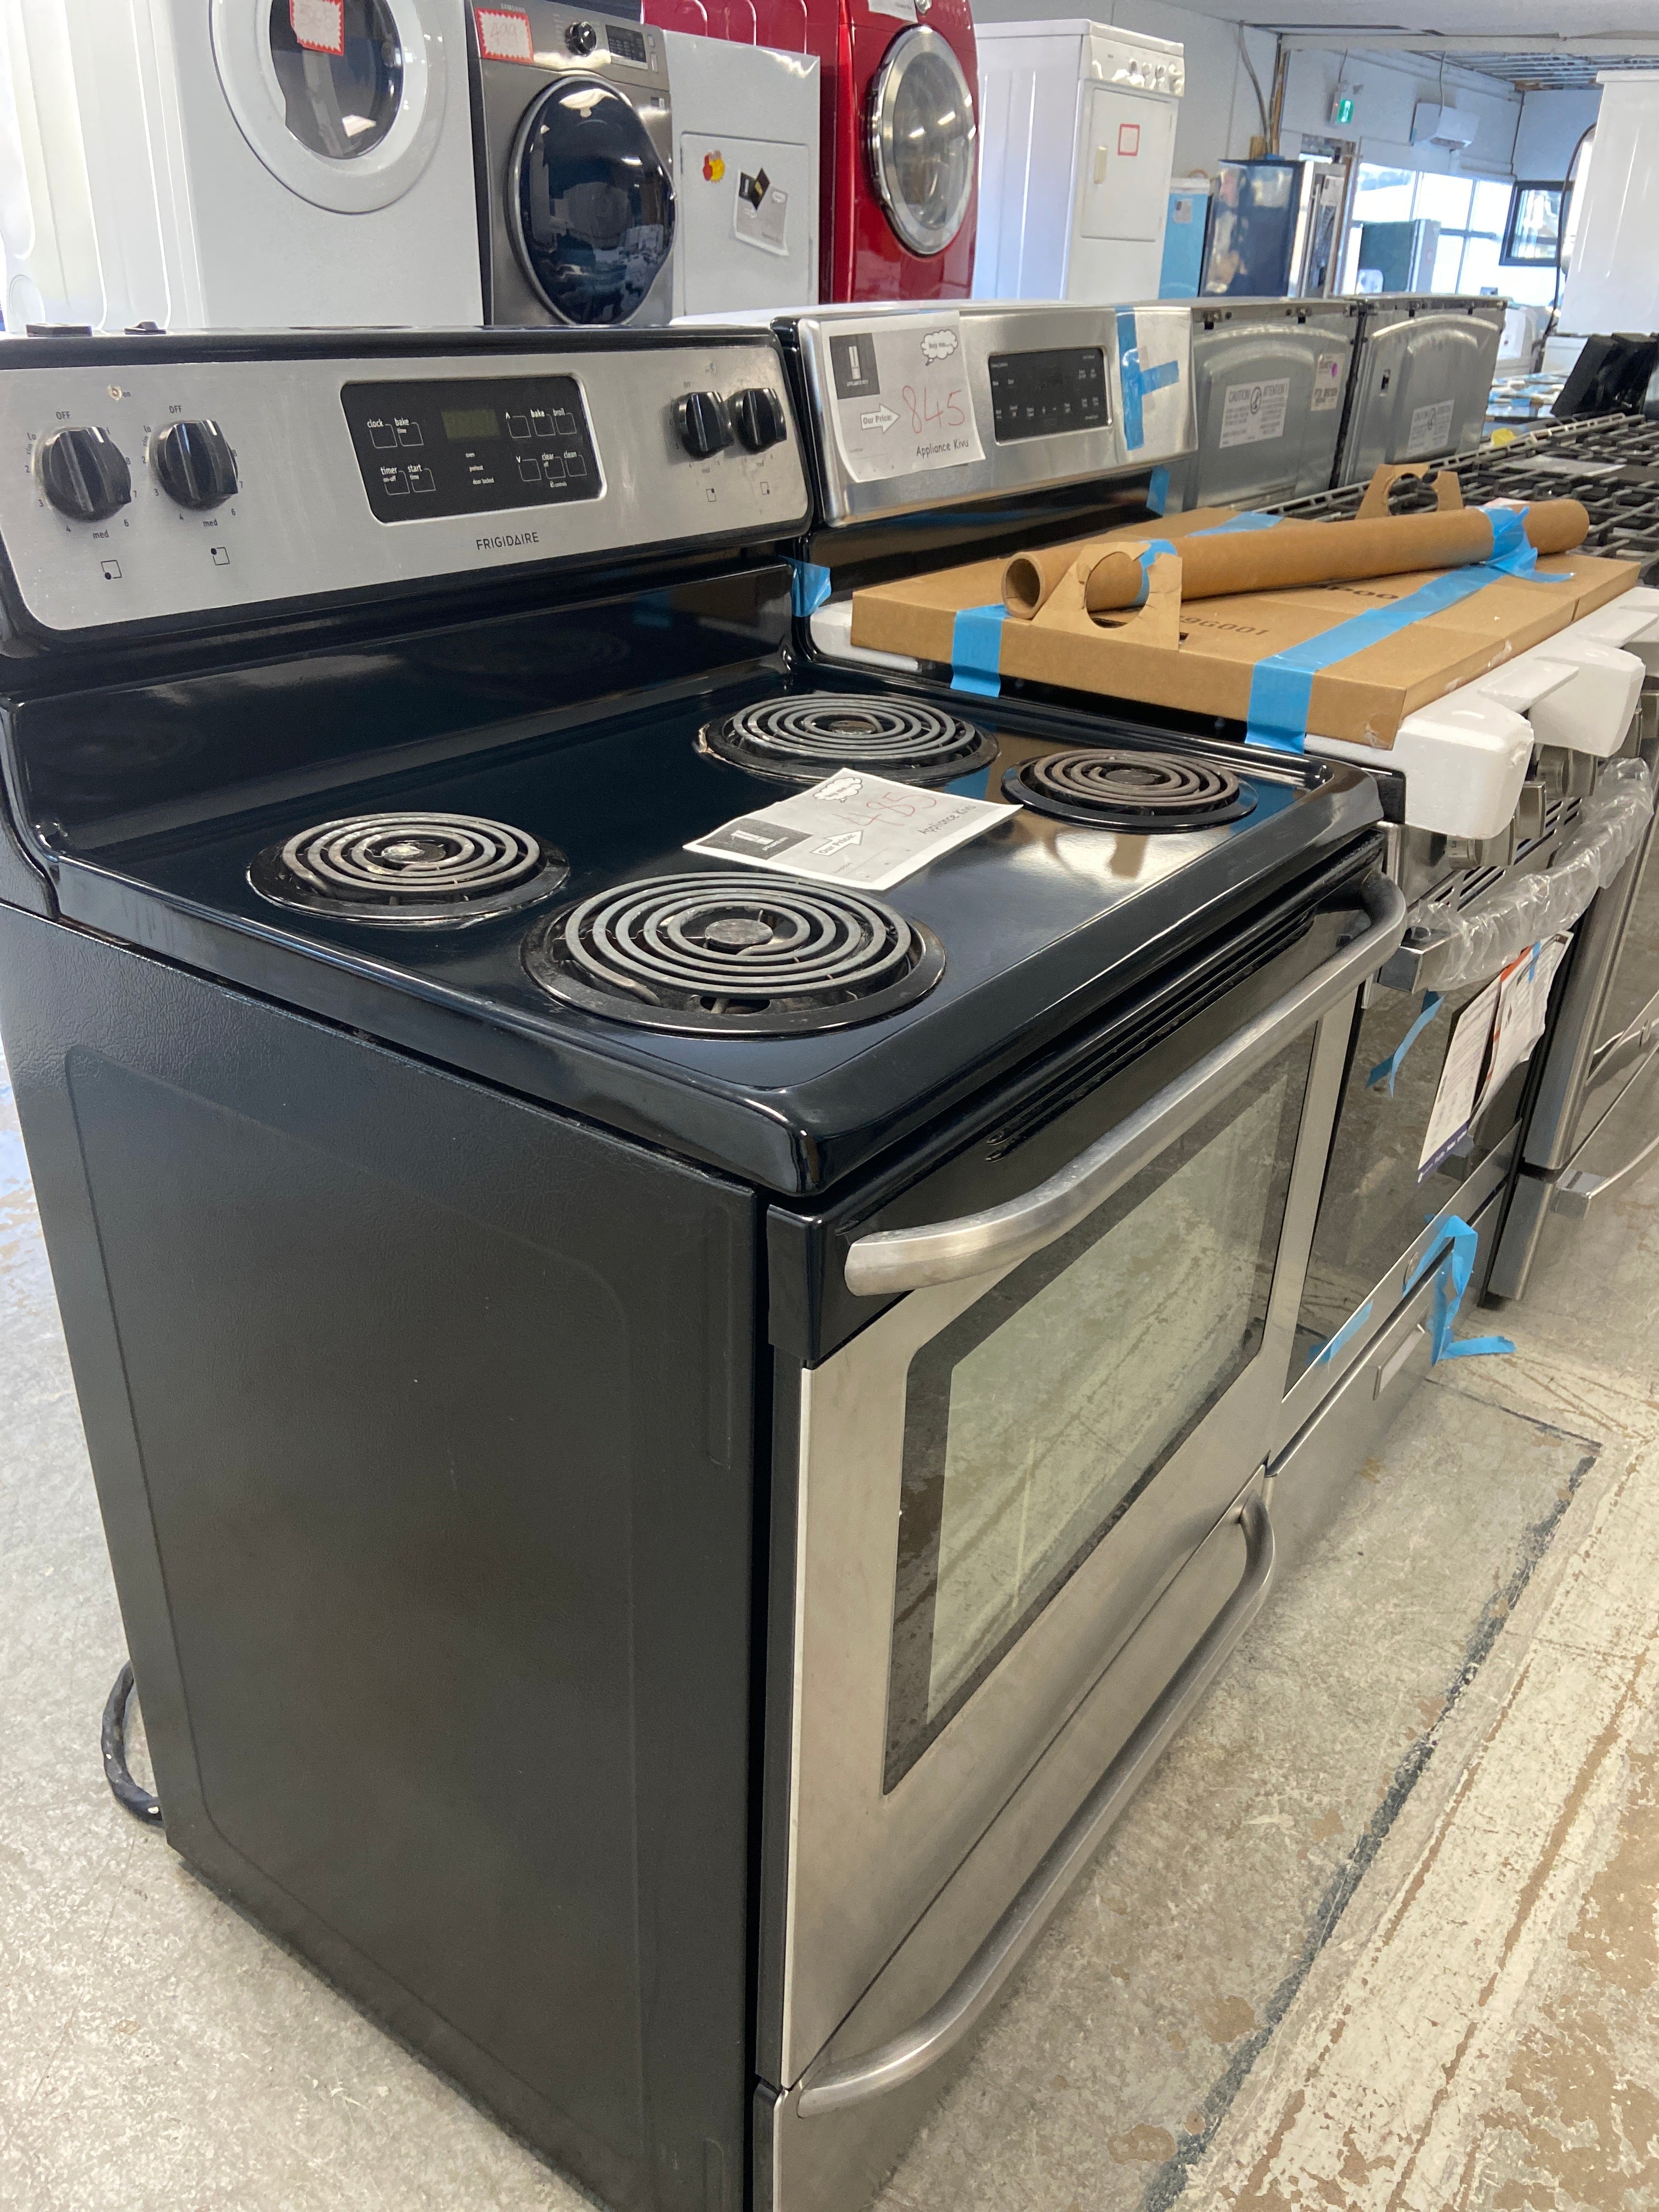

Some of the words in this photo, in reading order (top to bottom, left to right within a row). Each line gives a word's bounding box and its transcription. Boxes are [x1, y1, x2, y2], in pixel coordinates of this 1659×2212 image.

[531, 409, 545, 417] bake
[553, 408, 566, 416] broil
[902, 385, 964, 434] 845
[56, 411, 70, 420] OFF
[367, 418, 383, 427] clock
[394, 417, 410, 426] bake
[916, 443, 951, 459] Appliance
[953, 439, 969, 449] Kivu
[541, 452, 554, 461] clear
[380, 466, 397, 475] timer
[407, 464, 422, 472] start
[93, 530, 109, 539] med
[476, 532, 539, 550] FRIGIDAIRE
[832, 792, 937, 826] 485
[917, 814, 959, 835] Appliance
[953, 804, 977, 816] Kivu
[819, 844, 835, 854] Our
